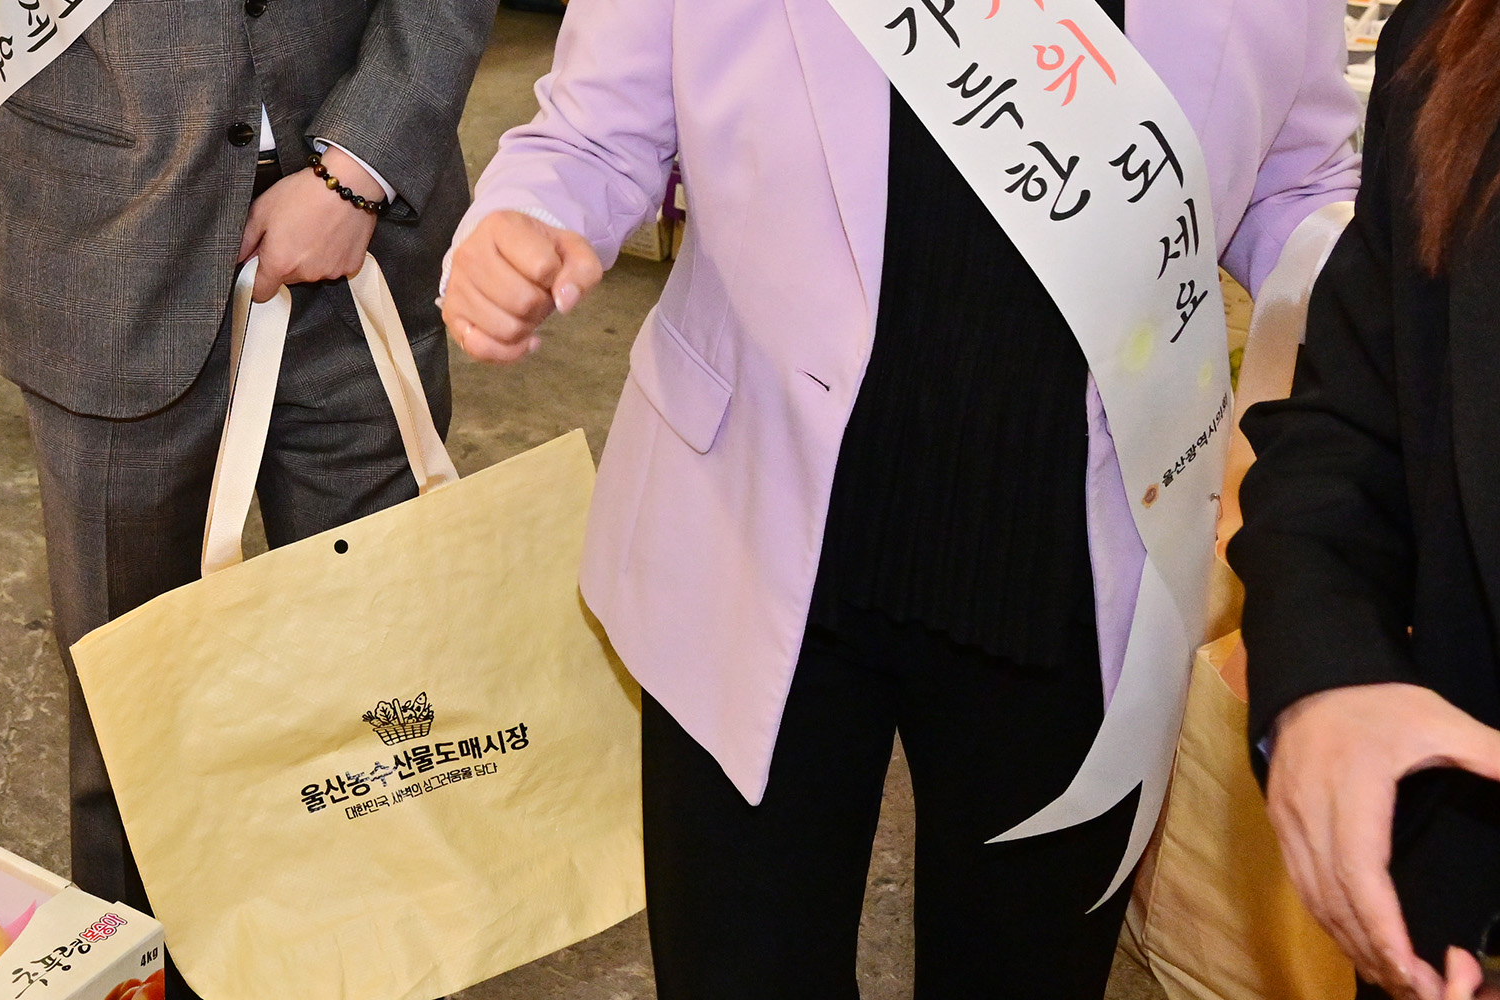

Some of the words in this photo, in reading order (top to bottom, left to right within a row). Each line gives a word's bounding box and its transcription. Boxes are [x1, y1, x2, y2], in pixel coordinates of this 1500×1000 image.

[1108, 118, 1209, 344] 되세요
[299, 722, 531, 814] 울산농수산물도매시장
[345, 795, 390, 820] 대한민국
[391, 783, 424, 805] 새벽의
[423, 766, 473, 793] 싱그러움을
[474, 762, 498, 777] 담다
[79, 913, 128, 943] 복숭아
[140, 947, 159, 967] 4kg
